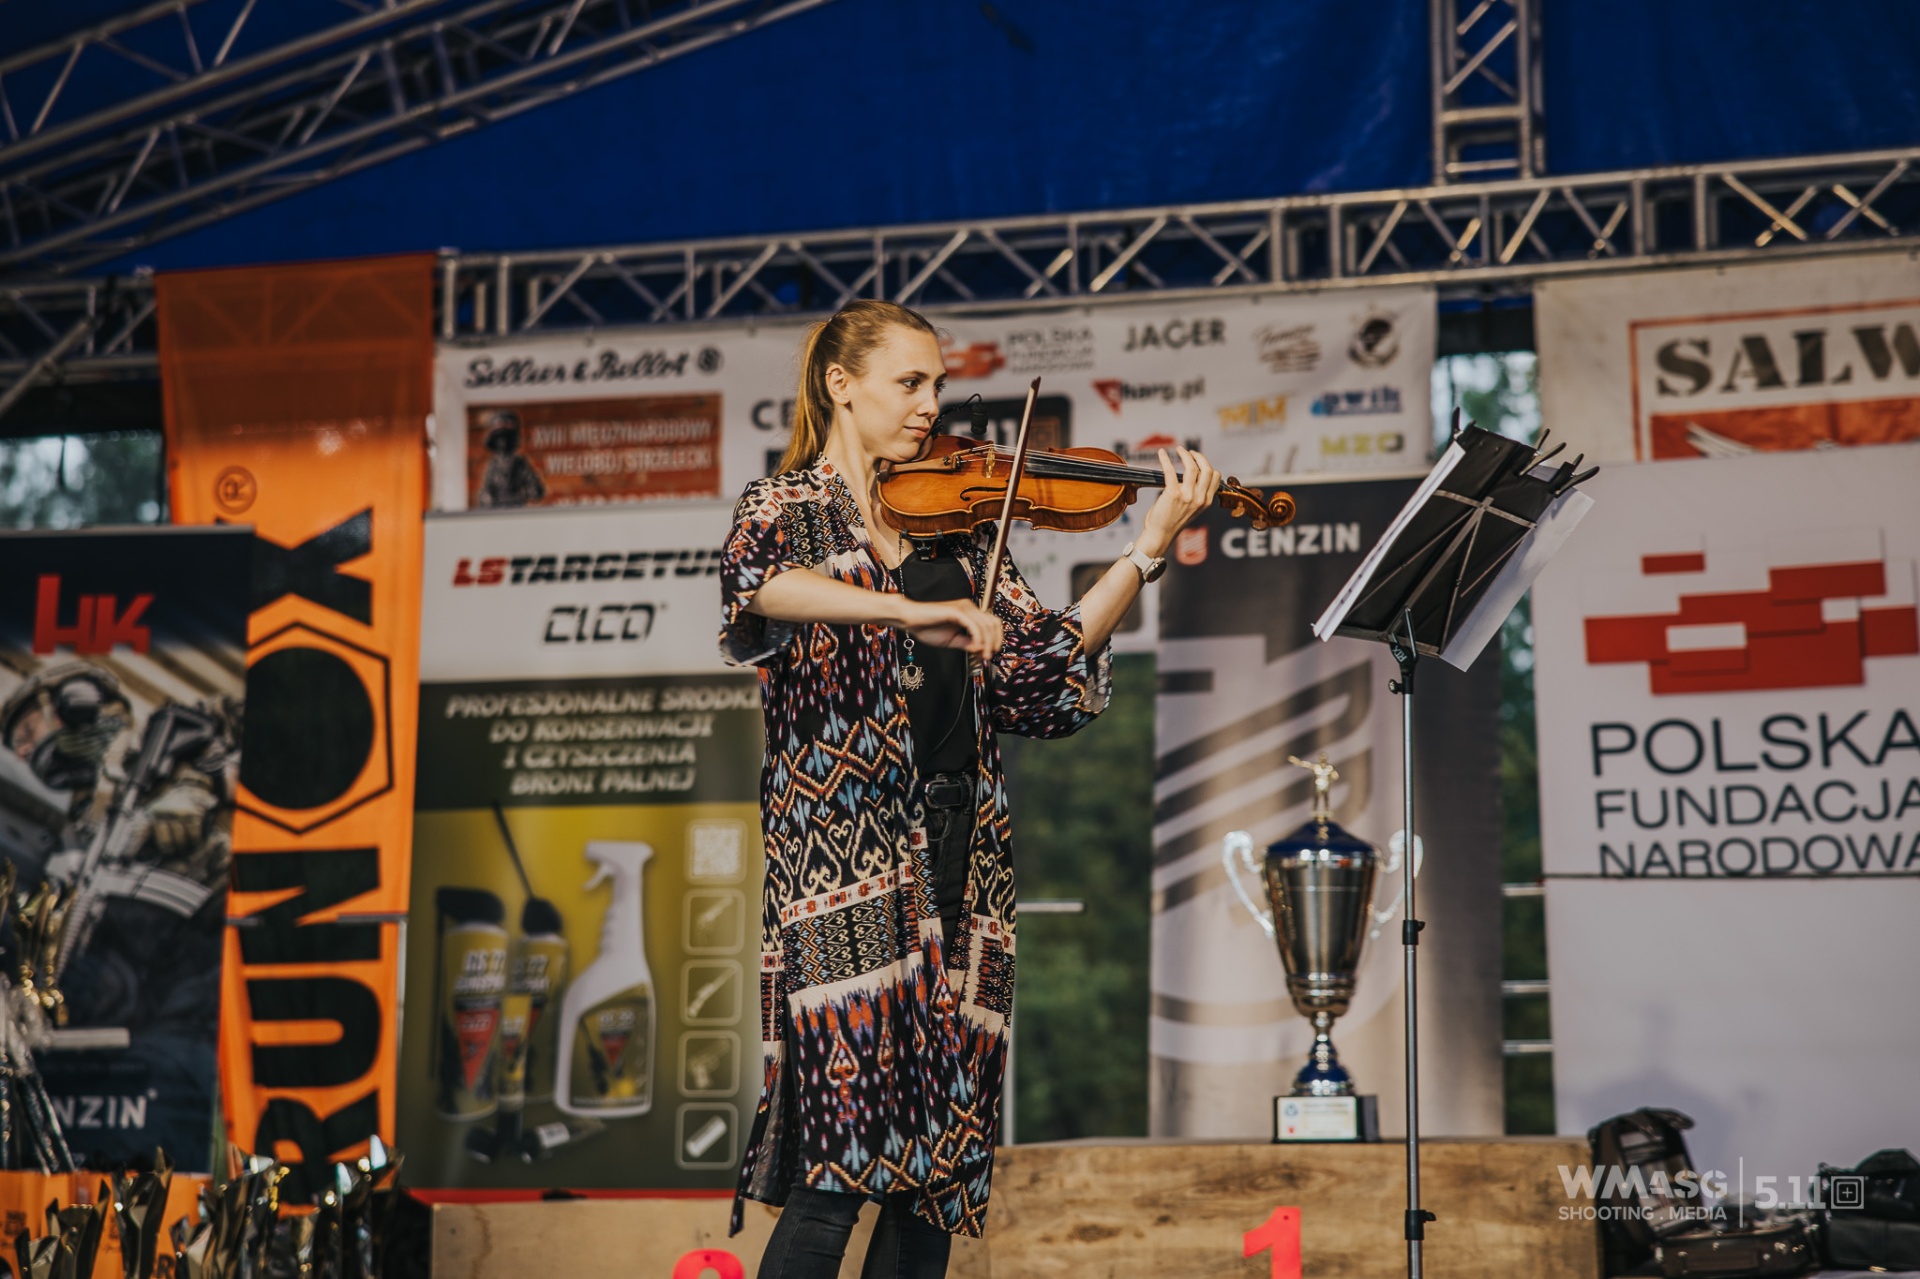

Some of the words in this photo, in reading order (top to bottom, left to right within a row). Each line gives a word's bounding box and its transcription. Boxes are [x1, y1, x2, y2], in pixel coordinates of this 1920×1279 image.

[592, 349, 689, 382] Bellot
[1221, 523, 1359, 558] CENZIN
[32, 574, 155, 655] HK
[446, 690, 654, 718] PROFESJONALNE
[490, 719, 529, 743] DO
[1591, 708, 1920, 777] POLSKA
[523, 742, 697, 768] CZYSZCZENIA
[510, 771, 598, 796] BRONI
[599, 767, 697, 791] PALNEJ
[1595, 777, 1920, 830] FUNDACJA
[53, 1095, 147, 1129] NZIN
[1243, 1206, 1303, 1279] 1
